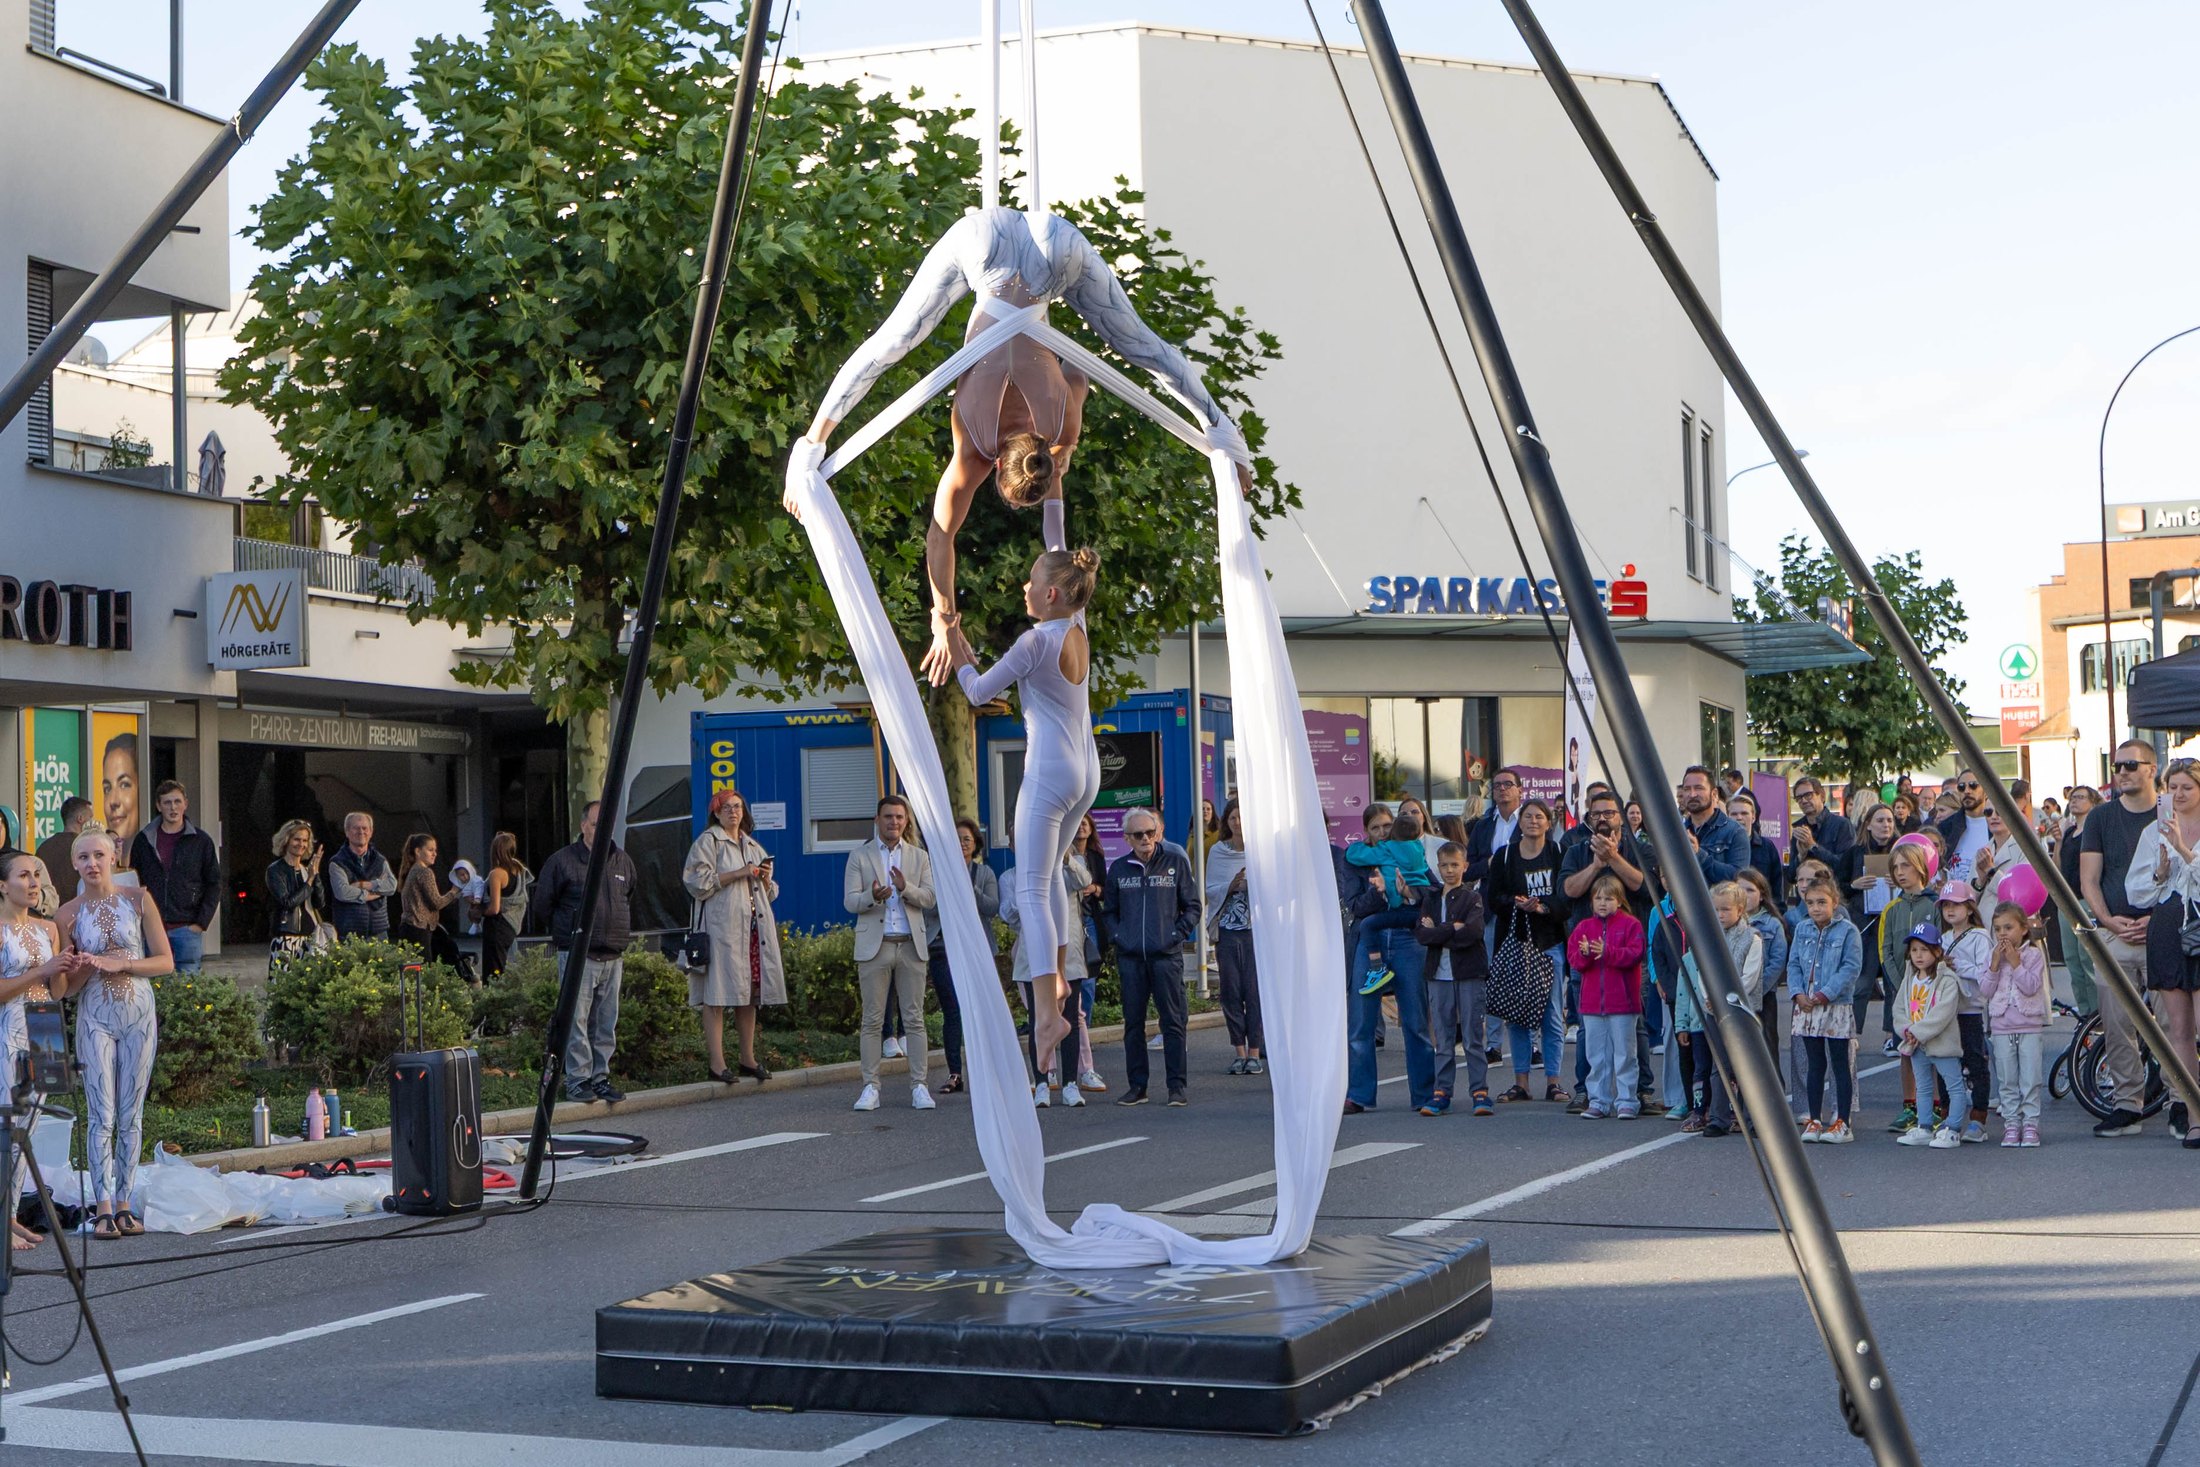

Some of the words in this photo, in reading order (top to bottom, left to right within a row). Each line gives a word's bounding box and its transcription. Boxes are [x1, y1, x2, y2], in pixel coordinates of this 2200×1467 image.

[2154, 508, 2183, 528] Am
[1366, 575, 1606, 615] SPARKAS
[0, 574, 131, 651] ROTH
[221, 641, 291, 658] HÖRGERÄTE
[2003, 711, 2038, 721] HUBER
[250, 714, 363, 745] PFARR-ZENTRUM
[368, 726, 418, 747] FREI-RAUM
[33, 754, 69, 784] HÖR
[1532, 777, 1563, 788] bauen
[1529, 789, 1545, 800] Sie
[34, 817, 55, 839] KE
[1525, 869, 1552, 889] KNY
[1528, 886, 1552, 897] ANS
